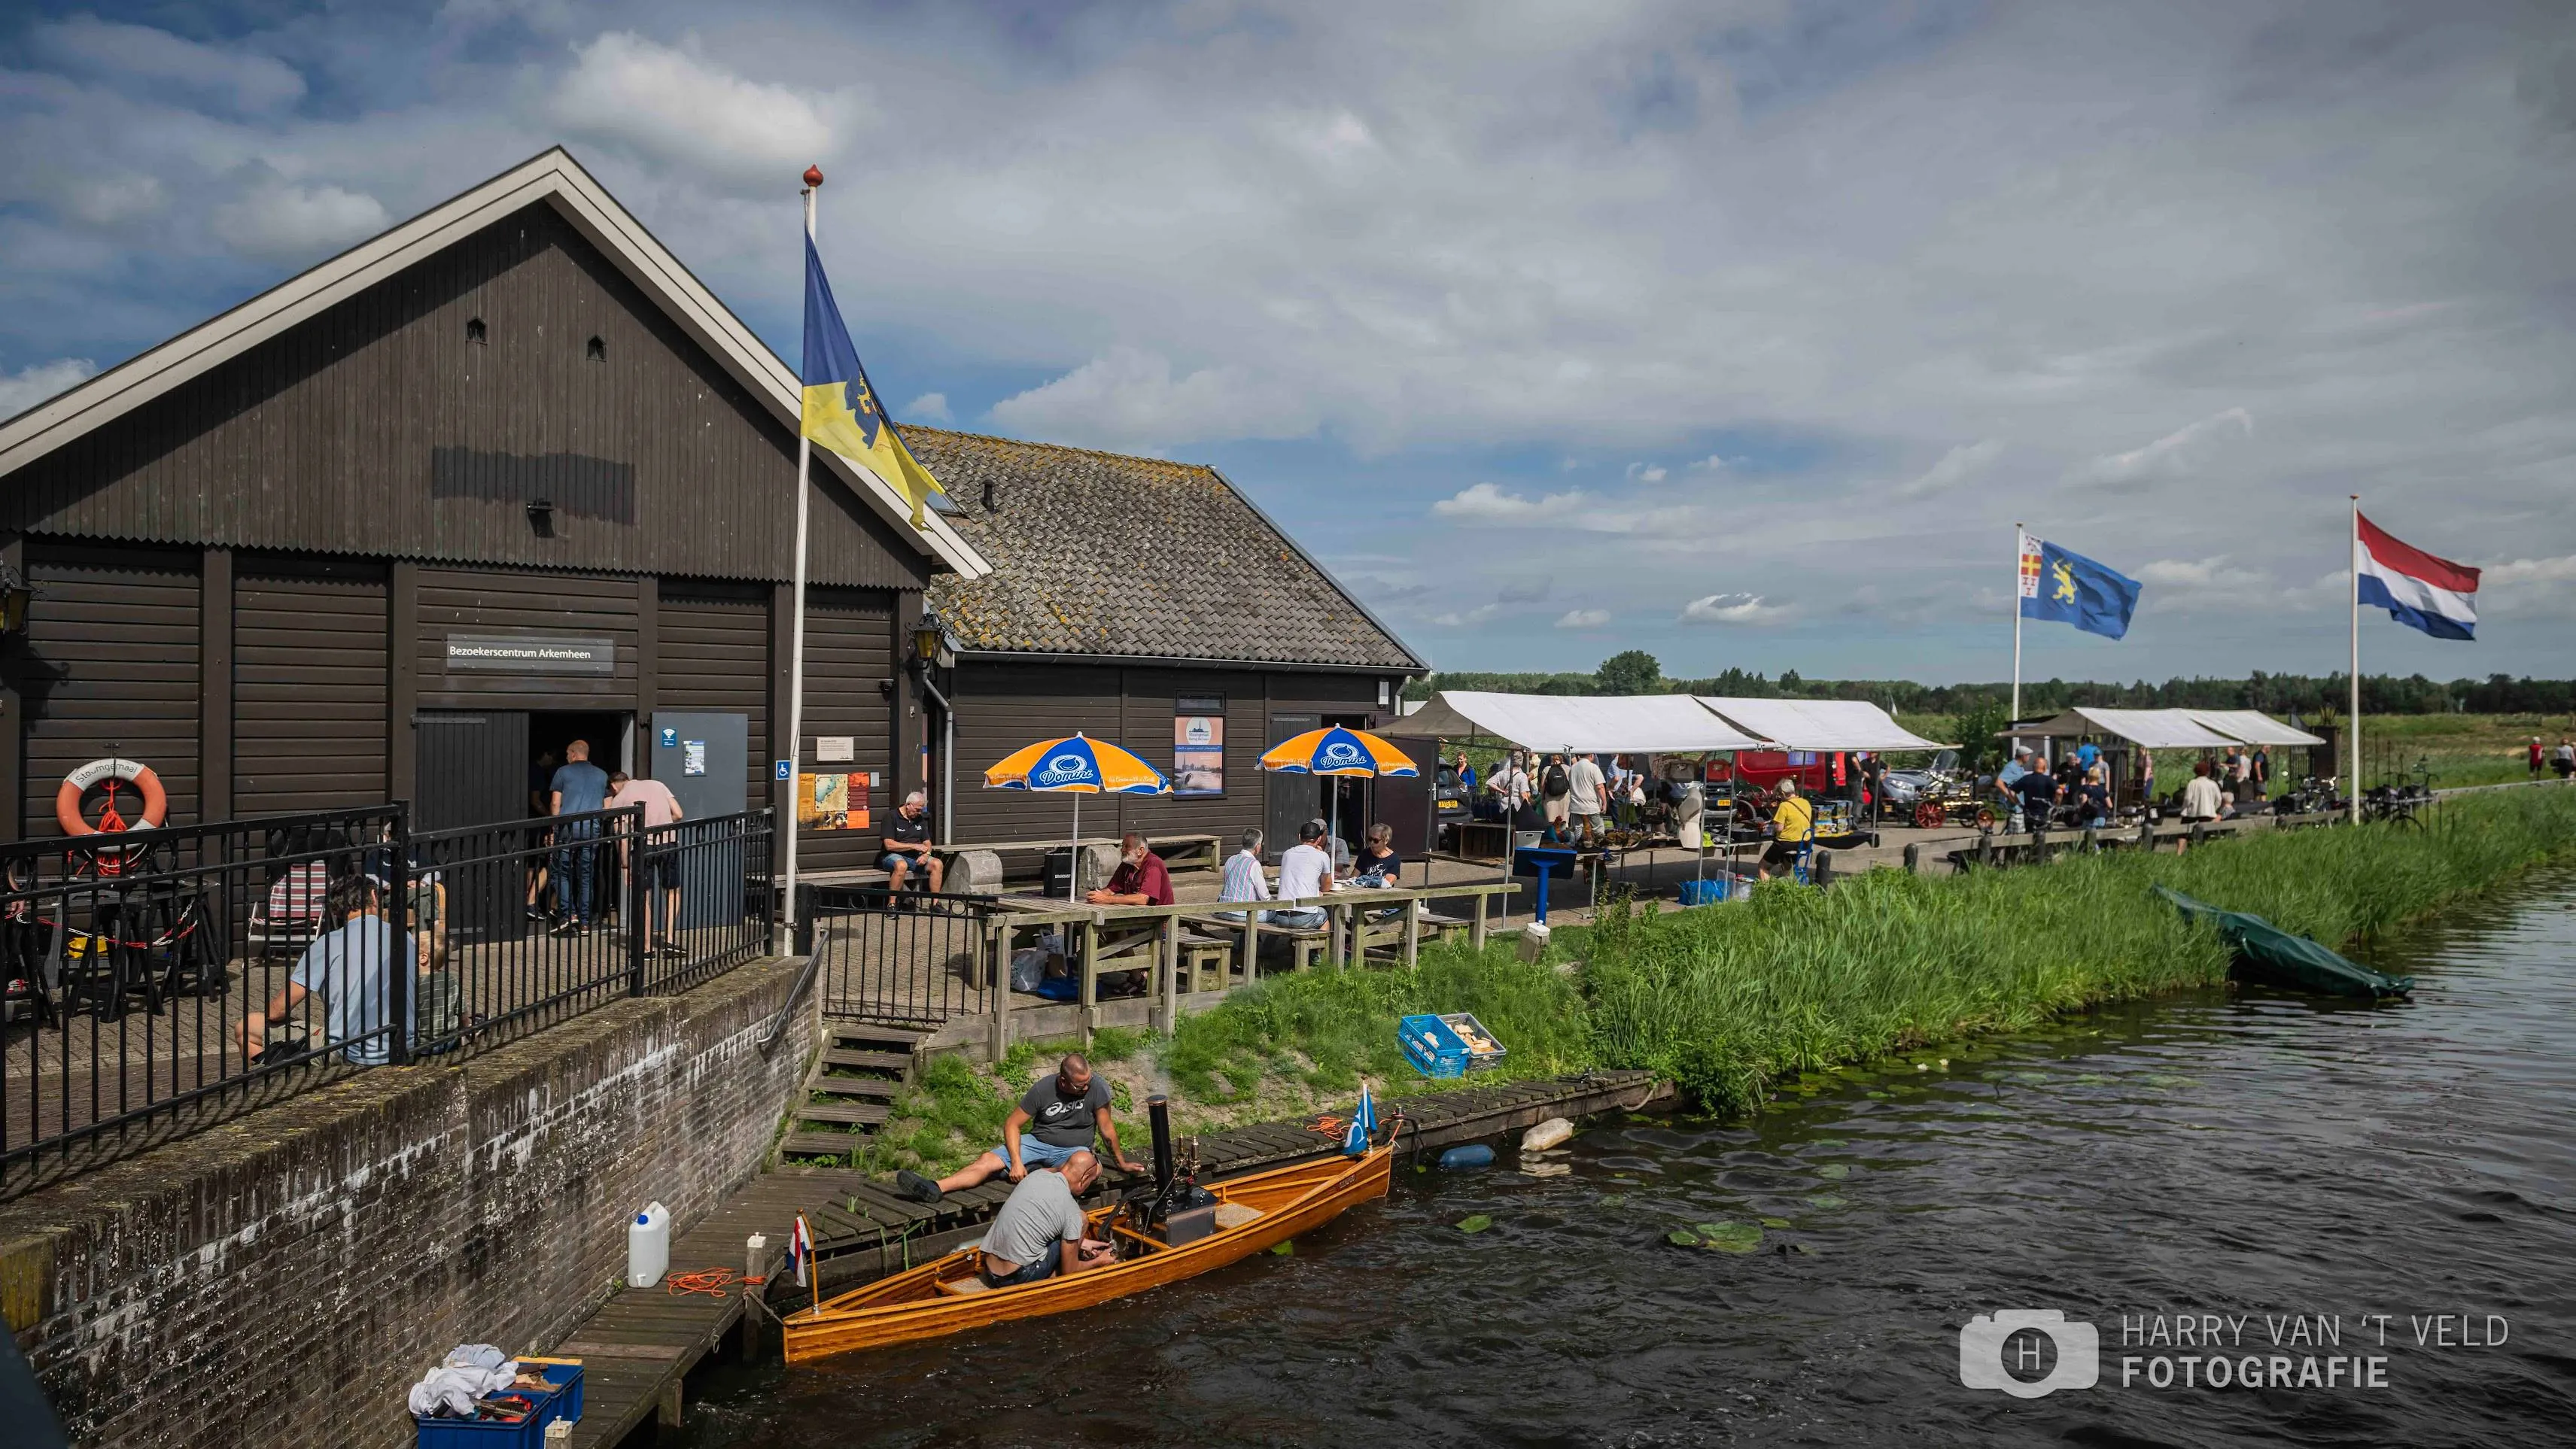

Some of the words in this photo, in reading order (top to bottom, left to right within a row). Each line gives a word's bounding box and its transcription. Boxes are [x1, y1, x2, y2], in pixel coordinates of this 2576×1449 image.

[449, 646, 537, 658] Bezoekerscentrum
[538, 649, 591, 659] Arkemheen
[1321, 756, 1367, 768] Domini
[1039, 770, 1093, 785] Domini
